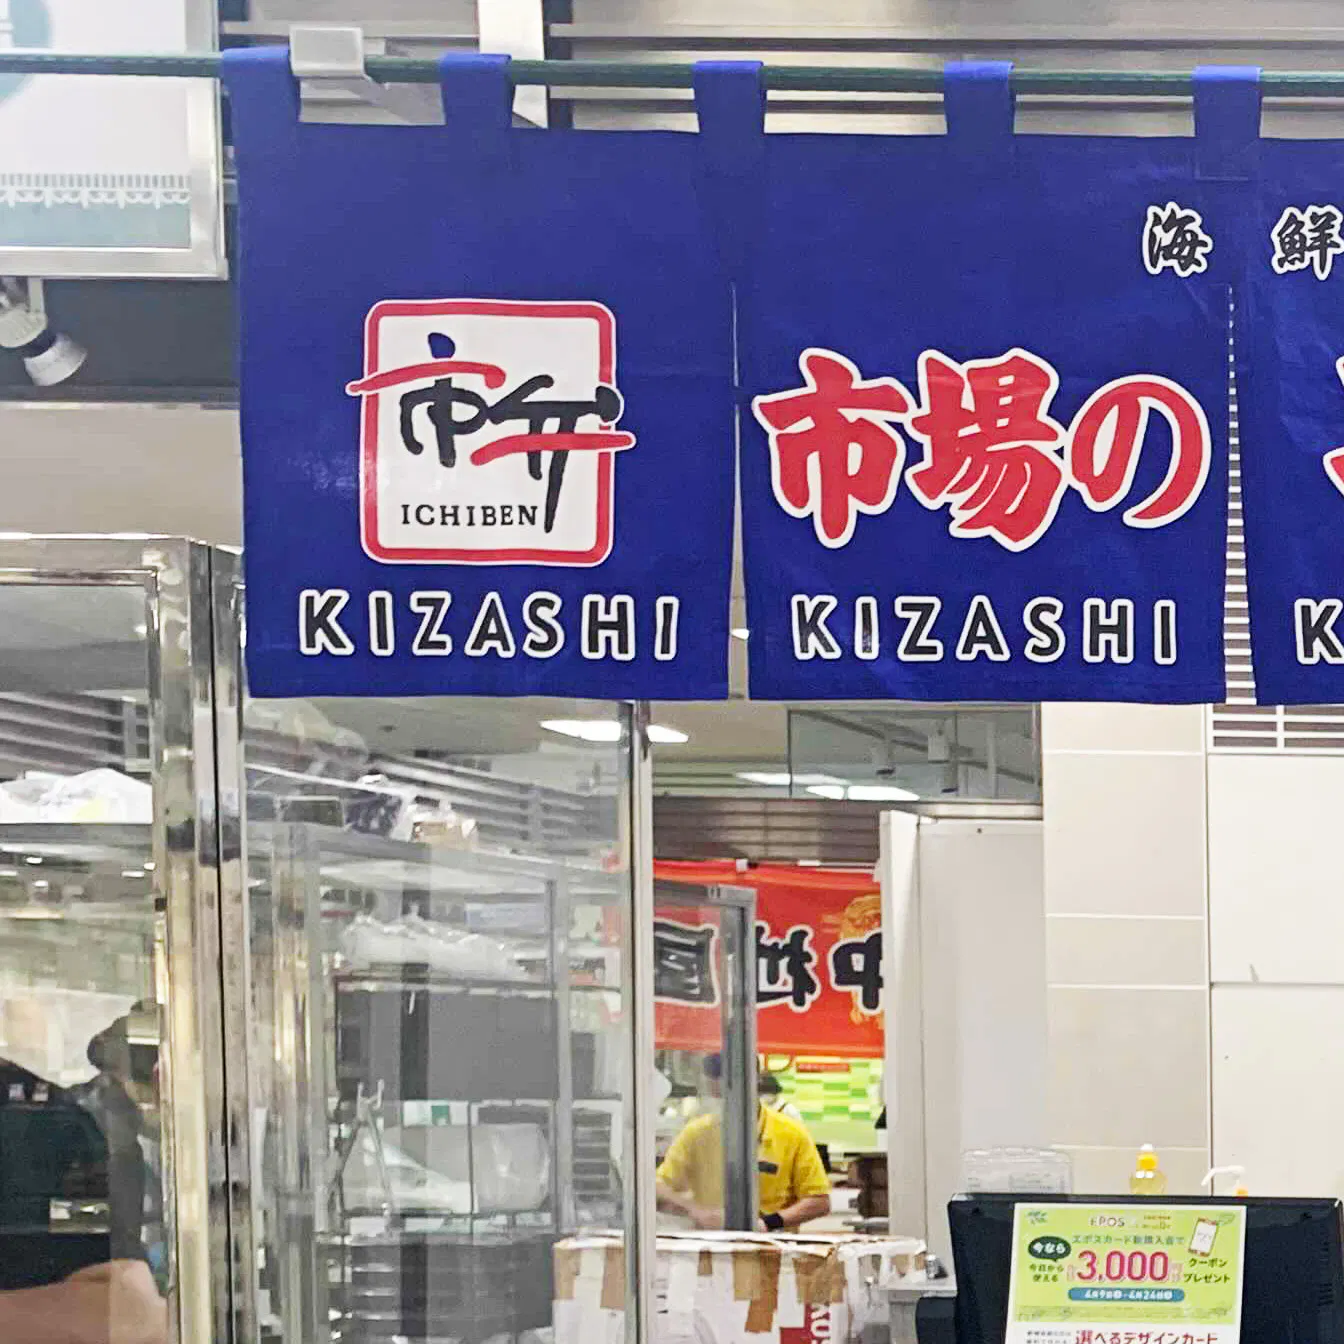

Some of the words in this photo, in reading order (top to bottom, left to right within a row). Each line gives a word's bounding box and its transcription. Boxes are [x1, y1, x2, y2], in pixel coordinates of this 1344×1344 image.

[753, 346, 1212, 552] 市場の
[401, 503, 539, 527] ICHIBEN
[299, 588, 681, 662] KIZASHI
[790, 593, 1178, 666] KIZASHI
[1188, 1257, 1228, 1269] クーポン
[1184, 1272, 1231, 1284] プレゼント
